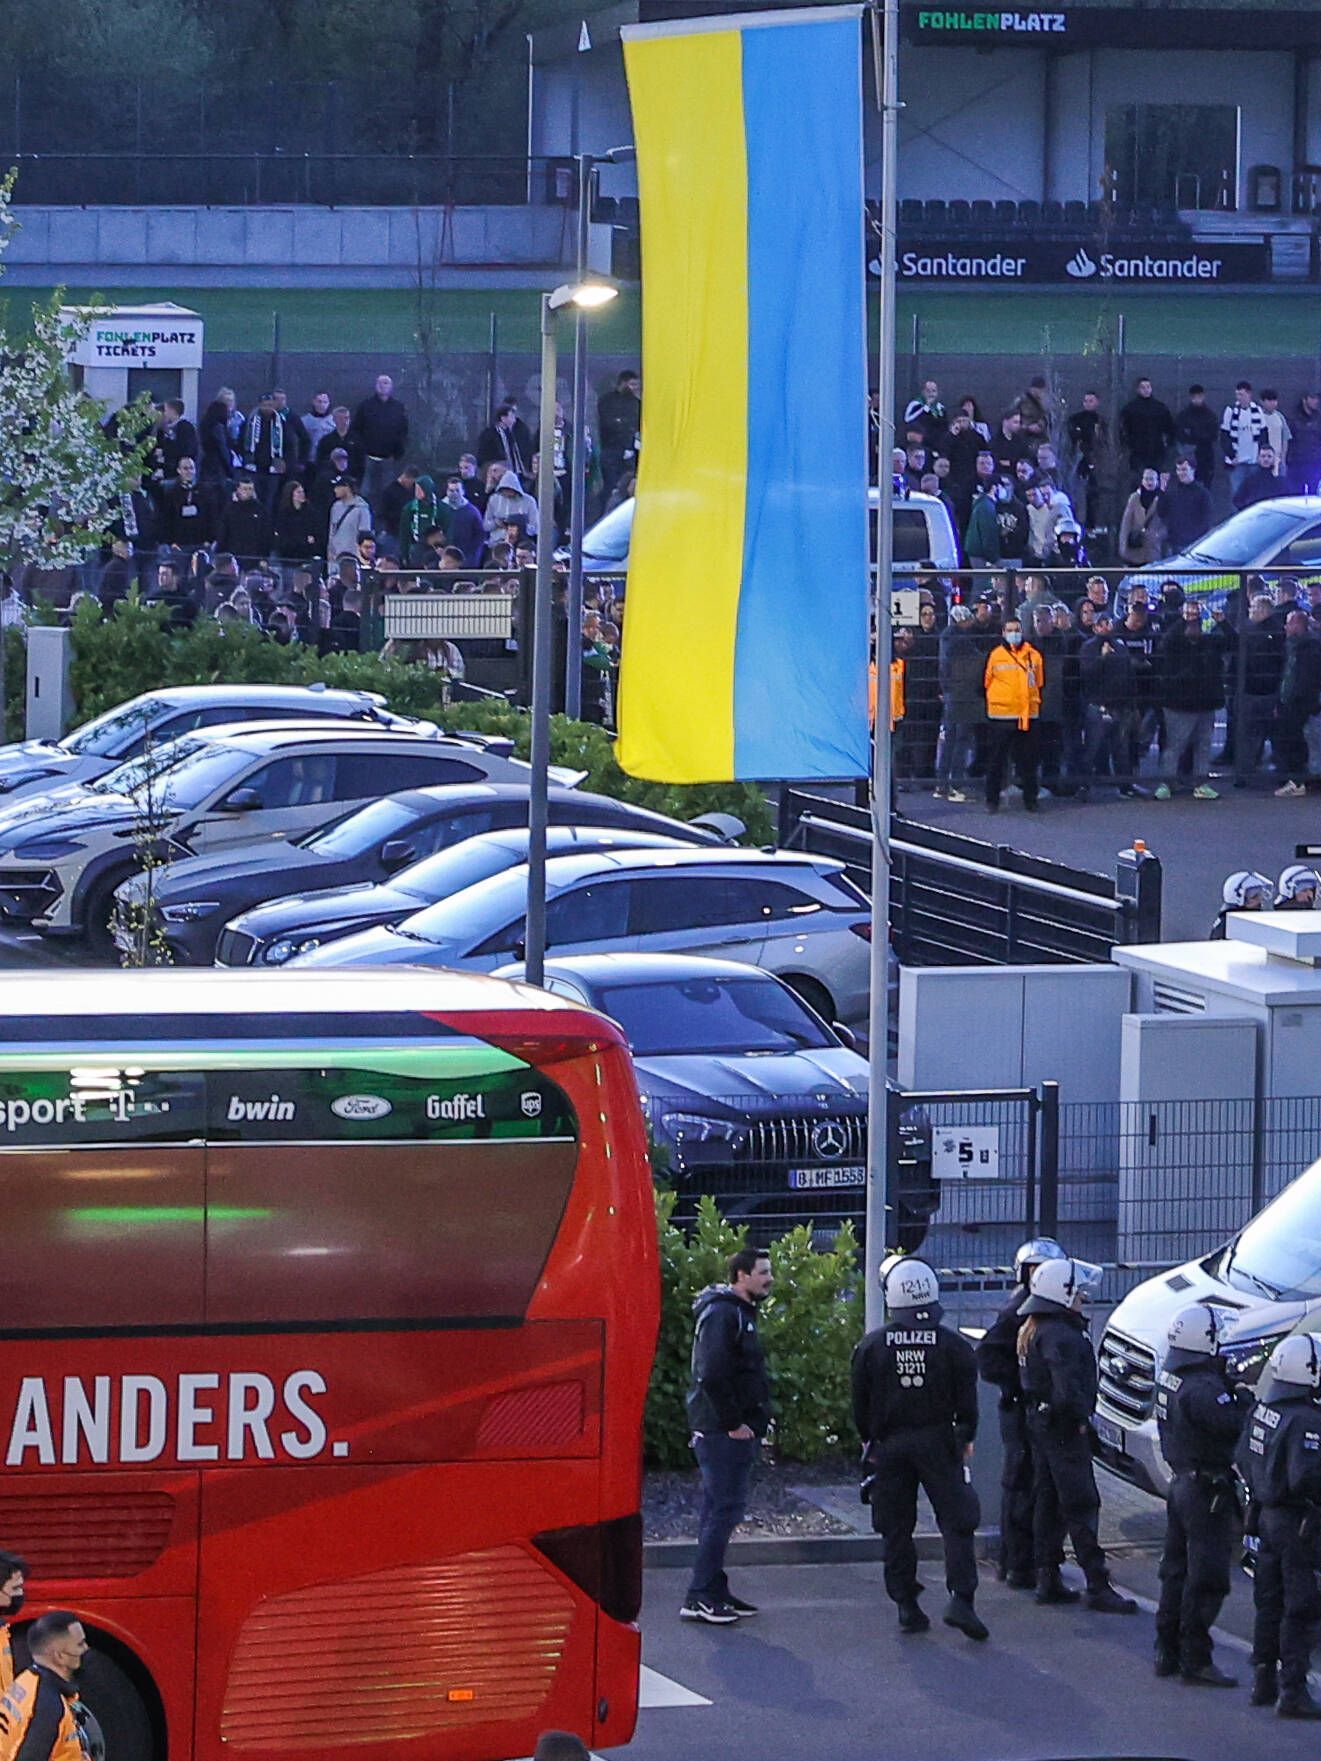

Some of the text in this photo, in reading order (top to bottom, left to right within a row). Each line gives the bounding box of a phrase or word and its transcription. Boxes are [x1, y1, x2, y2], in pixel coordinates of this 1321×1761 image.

[918, 12, 1065, 31] FOHLENPLATZ
[902, 252, 1026, 277] Santander
[1100, 254, 1222, 278] Santander
[96, 345, 156, 357] TICKETS
[227, 1094, 295, 1120] bwin
[343, 1099, 379, 1114] Ford
[427, 1094, 486, 1121] Gaffel
[958, 1142, 974, 1163] 5
[886, 1330, 936, 1346] POLIZEI
[896, 1349, 926, 1362] NRW
[896, 1362, 926, 1375] 31211
[6, 1369, 349, 1466] ANDERS.
